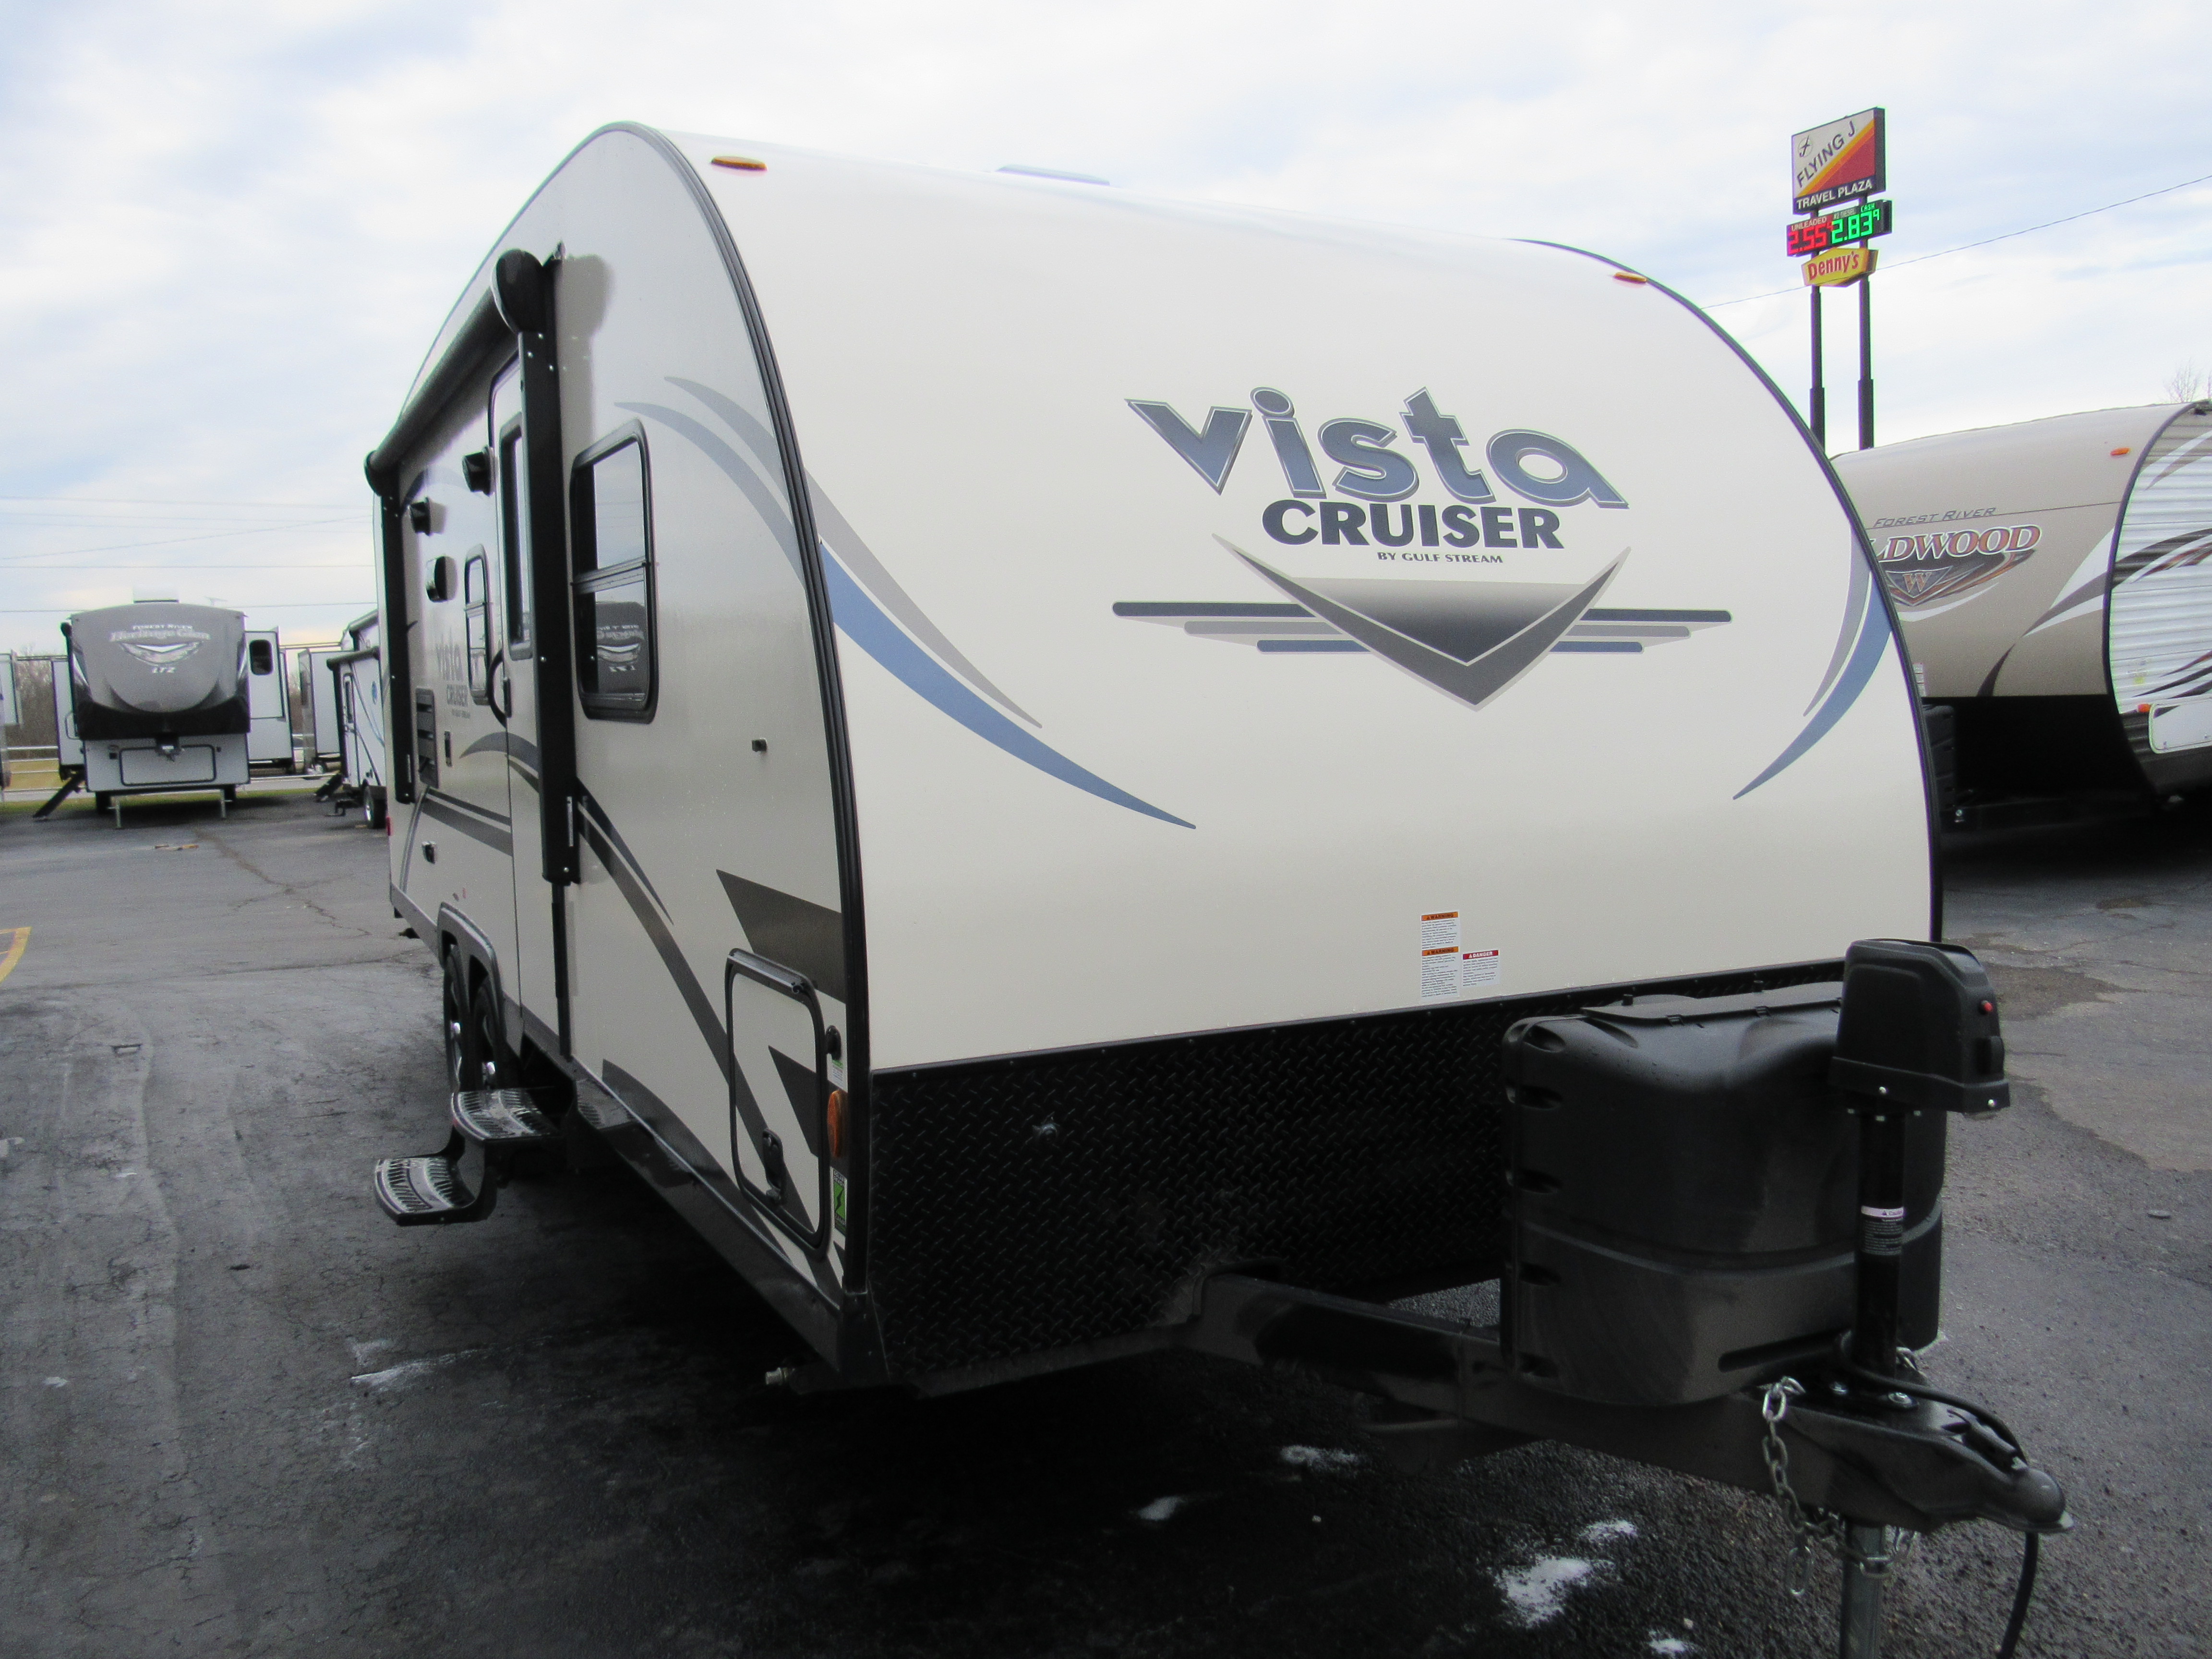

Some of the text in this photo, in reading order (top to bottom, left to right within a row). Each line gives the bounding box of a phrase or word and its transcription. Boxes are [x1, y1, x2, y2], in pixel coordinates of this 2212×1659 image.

[1796, 120, 1856, 188] FLYING J
[1796, 179, 1872, 210] TRAVEL PLAZA
[1861, 204, 1875, 212] CASH
[1791, 216, 1827, 231] UNLEADED
[1807, 251, 1860, 280] Denny's
[1124, 386, 1630, 509] vista
[1262, 499, 1564, 549] CRUISER
[1873, 507, 1997, 528] FOREST RIVER
[1377, 552, 1503, 564] BY GULF STREAM
[1870, 524, 2043, 563] DWOOD
